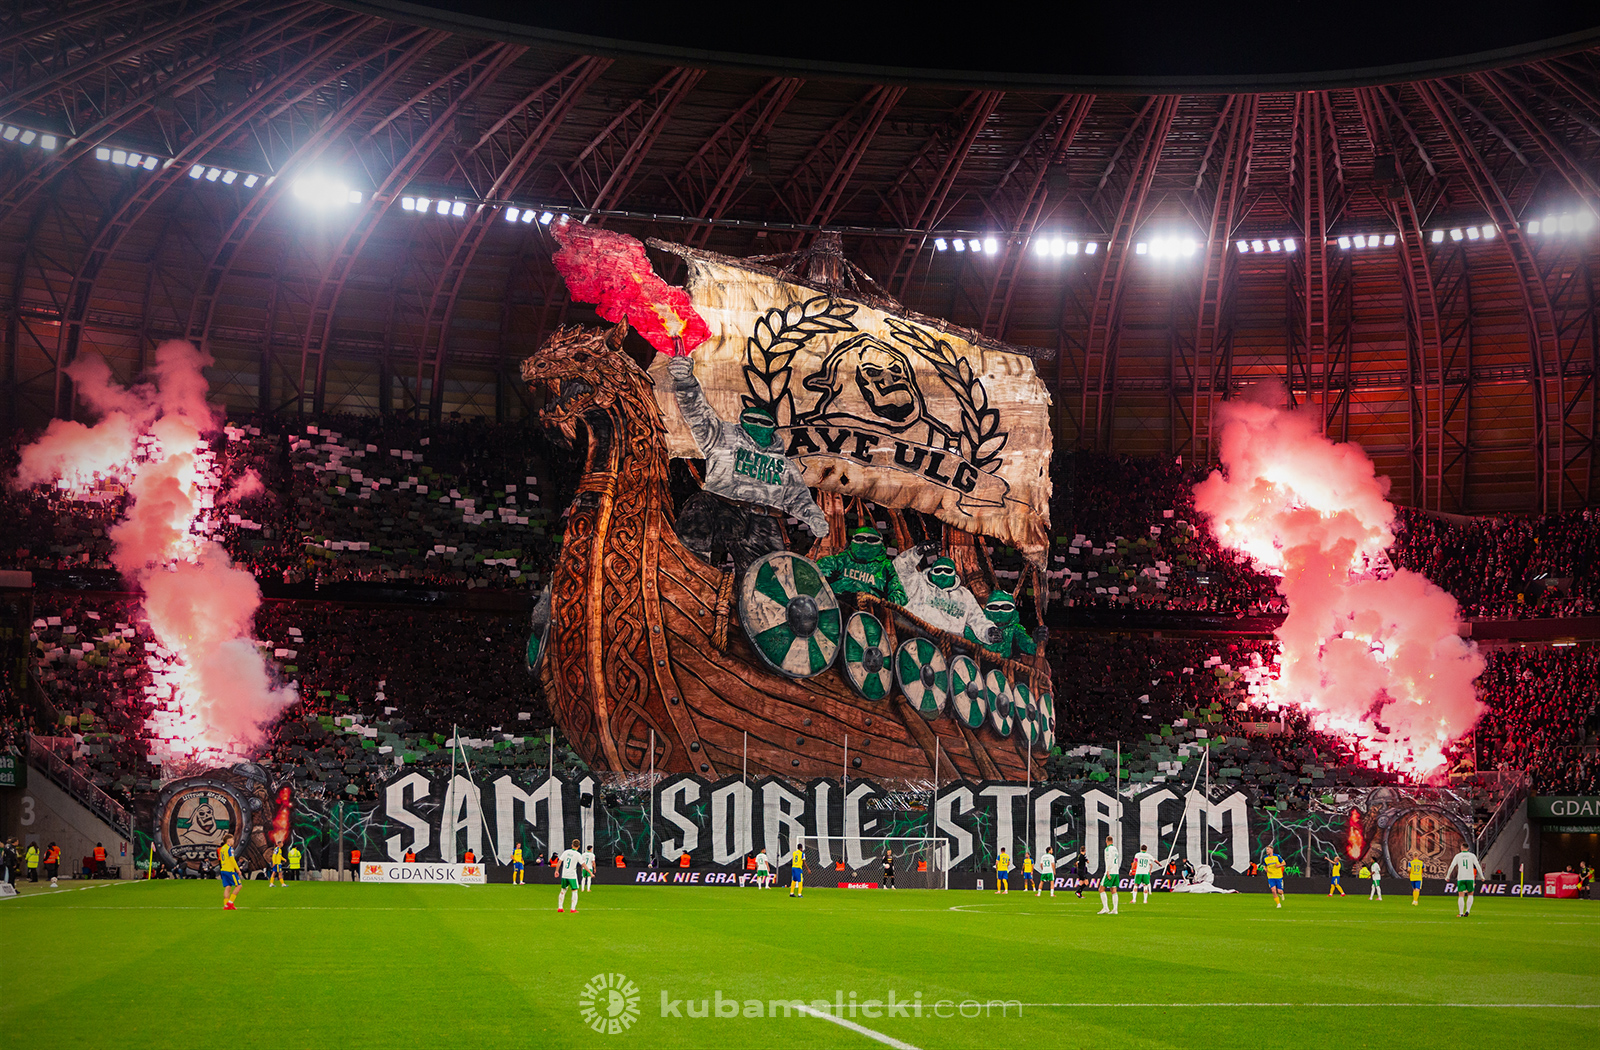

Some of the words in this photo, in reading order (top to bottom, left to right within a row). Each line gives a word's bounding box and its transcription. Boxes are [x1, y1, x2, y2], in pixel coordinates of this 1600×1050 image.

[735, 447, 784, 474] ULTRAS
[894, 441, 978, 493] ULG
[735, 459, 782, 485] LECHIA
[843, 567, 876, 586] LECHIA
[20, 796, 36, 826] 3
[1550, 800, 1600, 816] GDA
[385, 772, 595, 866] SAMI
[661, 777, 877, 870] SOBIE
[936, 786, 1249, 874] STEREM
[1522, 823, 1531, 850] 2
[565, 857, 572, 870] 3
[1413, 864, 1421, 872] 19
[1462, 859, 1469, 870] 4
[389, 866, 455, 880] GDAŃSK
[635, 872, 670, 883] RAK
[673, 872, 701, 883] NIE
[704, 873, 737, 884] GRA
[743, 873, 777, 884] FAIR
[1480, 883, 1507, 894] NIE
[1511, 883, 1543, 895] GRA
